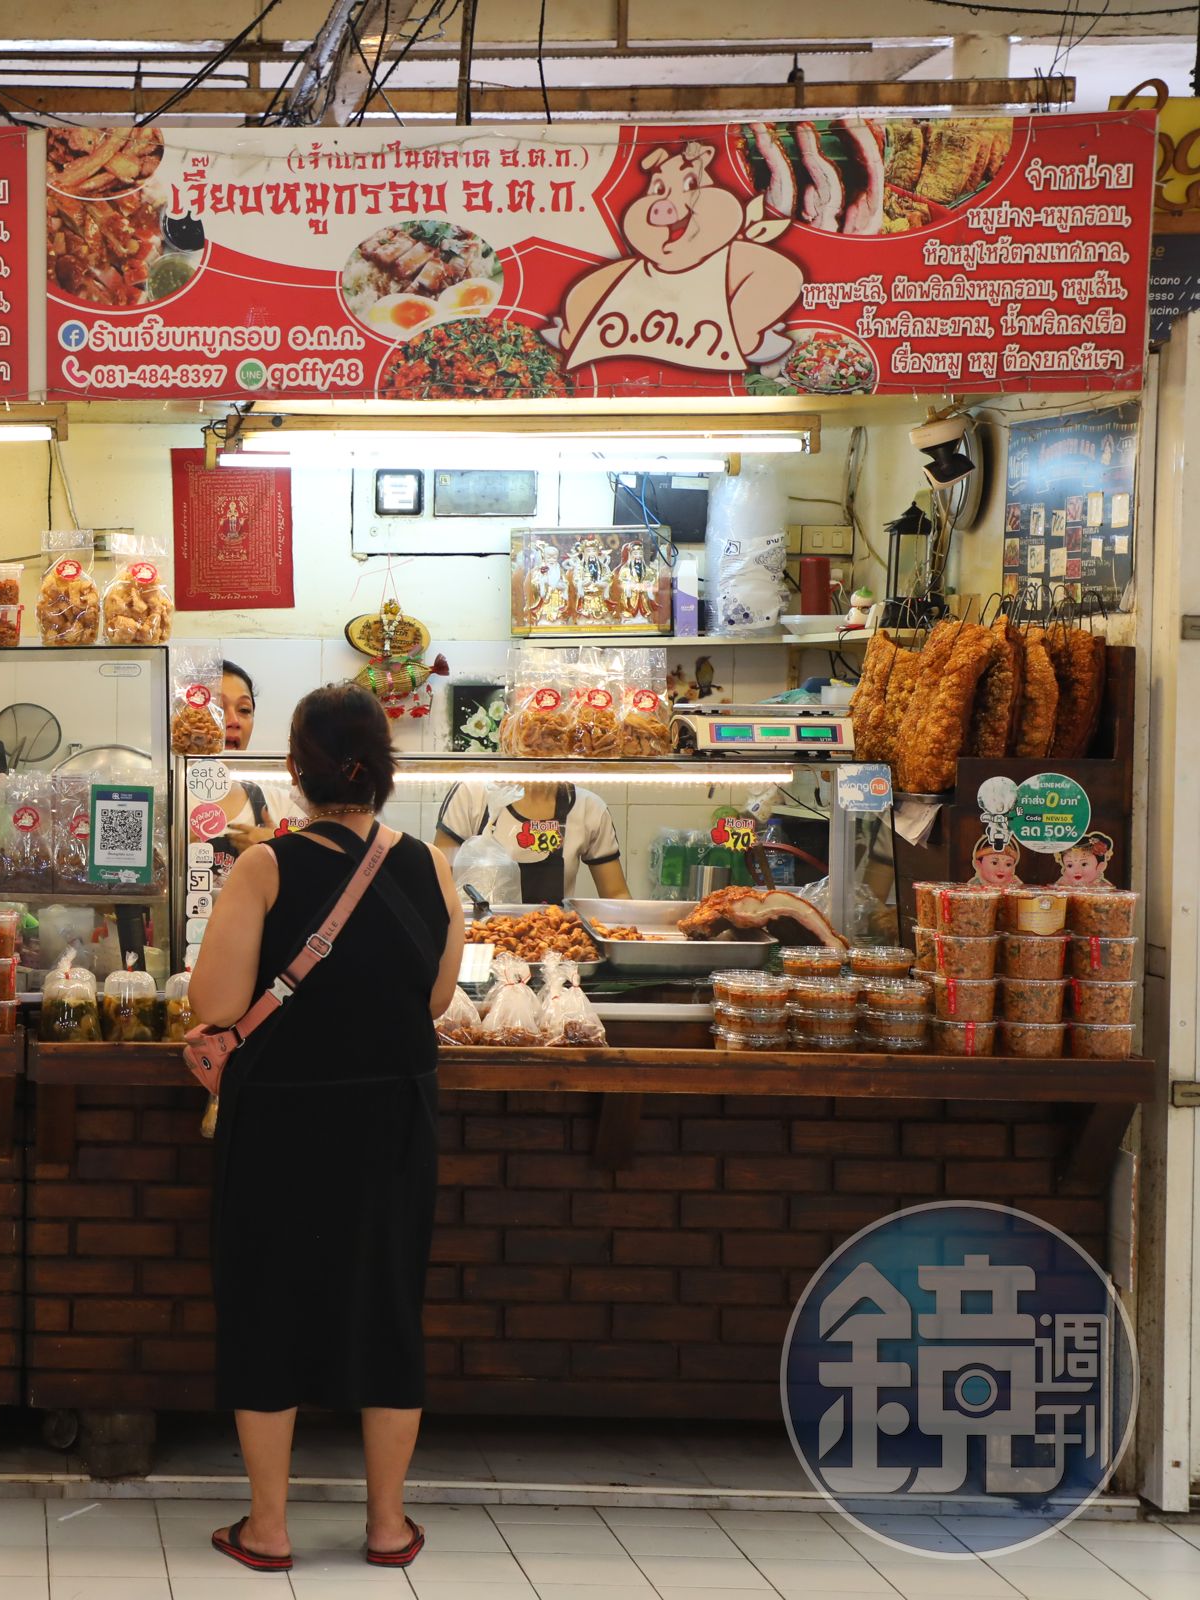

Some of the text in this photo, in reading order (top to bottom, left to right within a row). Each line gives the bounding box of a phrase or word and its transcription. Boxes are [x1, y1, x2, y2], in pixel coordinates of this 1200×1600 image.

[1025, 156, 1133, 191] จำหน่าย
[462, 179, 586, 215] อ.ต.ก.
[92, 318, 363, 356] ร้านเจี๊ยบหมูกรอบ อ.ต.ก.
[597, 309, 730, 361] อ.ต.ก.
[94, 367, 225, 386] 081-484-8397
[241, 369, 263, 381] LINE
[270, 362, 361, 388] goffy48
[968, 354, 997, 379] หมู
[191, 767, 226, 778] eat &
[1025, 814, 1042, 822] Code
[731, 831, 751, 849] 70
[1020, 825, 1078, 837] ลด 50%
[538, 832, 558, 852] 80
